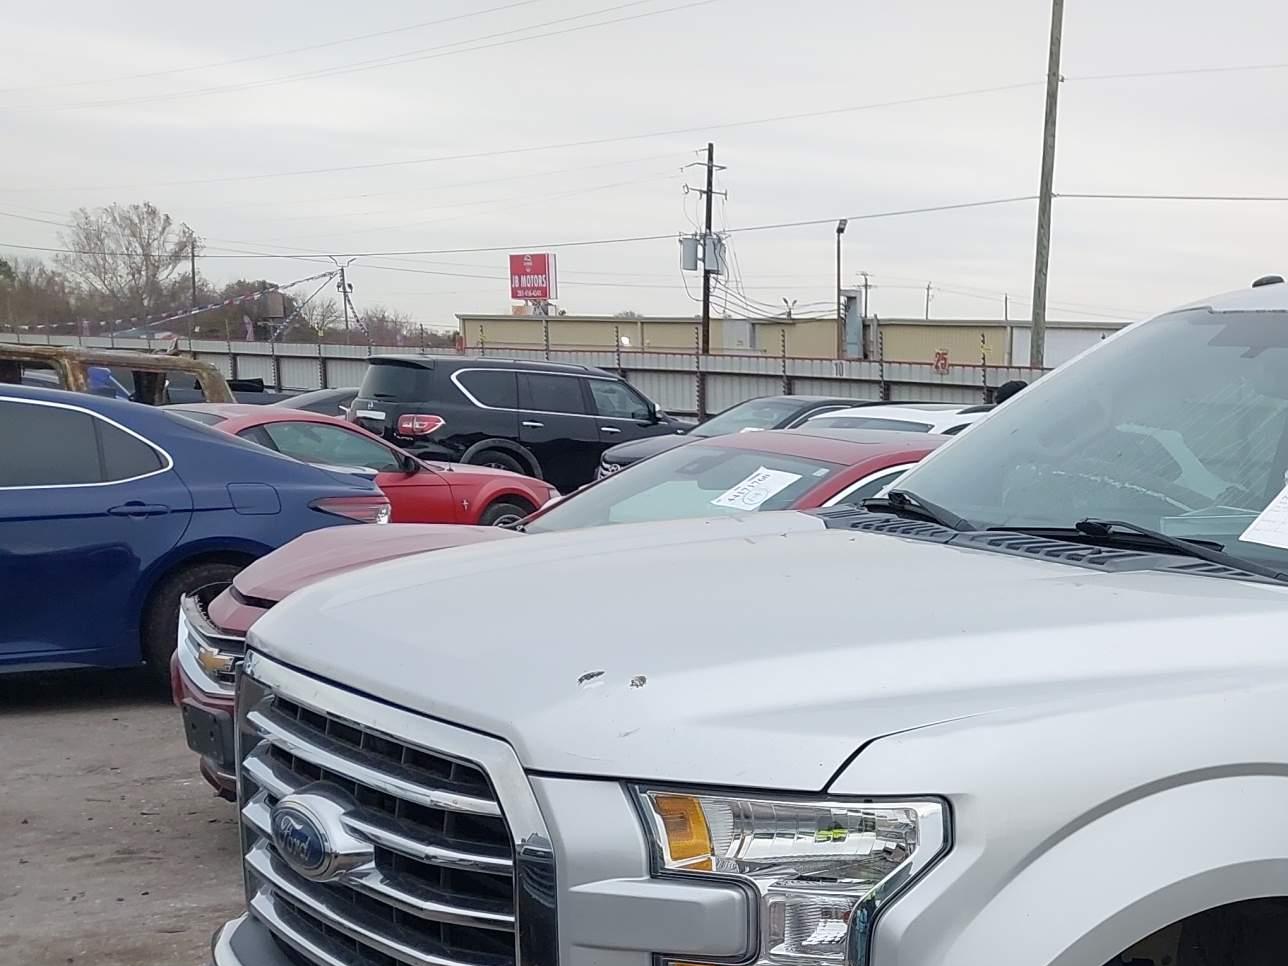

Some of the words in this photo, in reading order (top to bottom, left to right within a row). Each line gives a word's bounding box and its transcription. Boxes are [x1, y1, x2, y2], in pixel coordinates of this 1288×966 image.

[520, 274, 547, 288] MOTORS
[935, 351, 948, 370] 25
[280, 815, 312, 861] Ford
